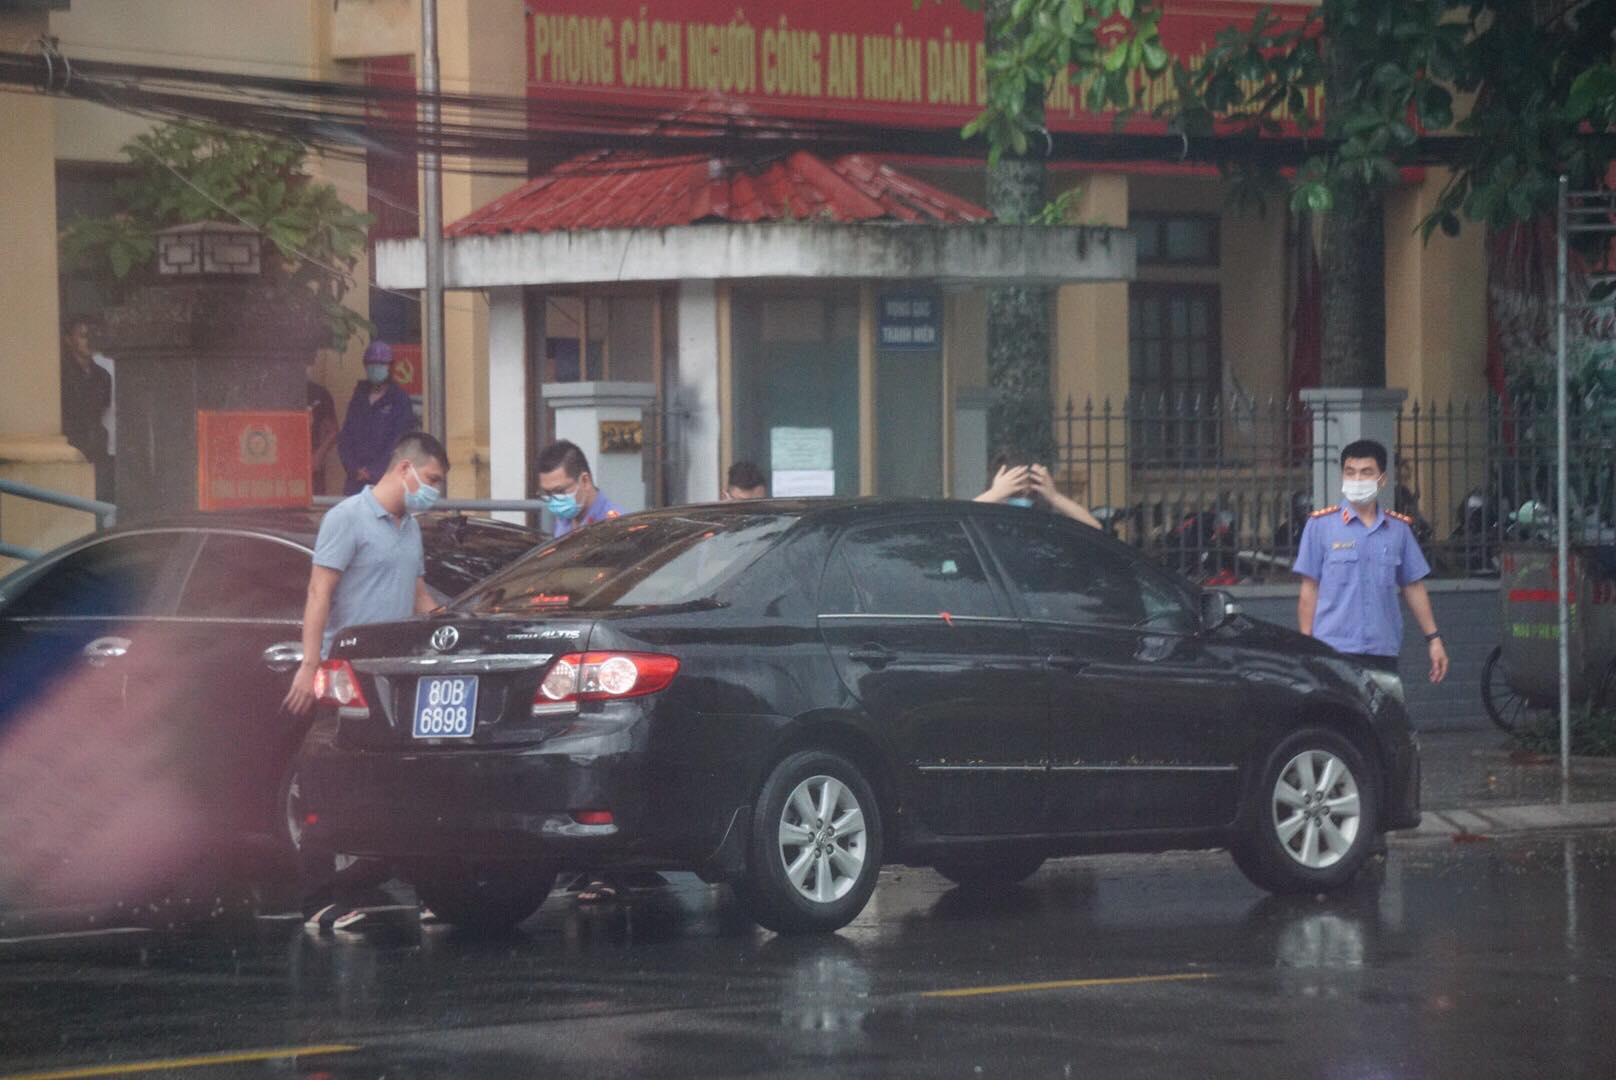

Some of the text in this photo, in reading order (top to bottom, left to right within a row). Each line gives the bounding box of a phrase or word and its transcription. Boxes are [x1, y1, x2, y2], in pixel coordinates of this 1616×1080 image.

[535, 15, 614, 84] PHONG
[621, 6, 681, 87] CÁCH
[761, 15, 821, 95] CÔNG
[828, 33, 857, 97] AN
[863, 23, 921, 101] NHÂN
[928, 27, 970, 104] DÂN
[429, 679, 465, 706] 80B
[420, 706, 468, 734] 6898
